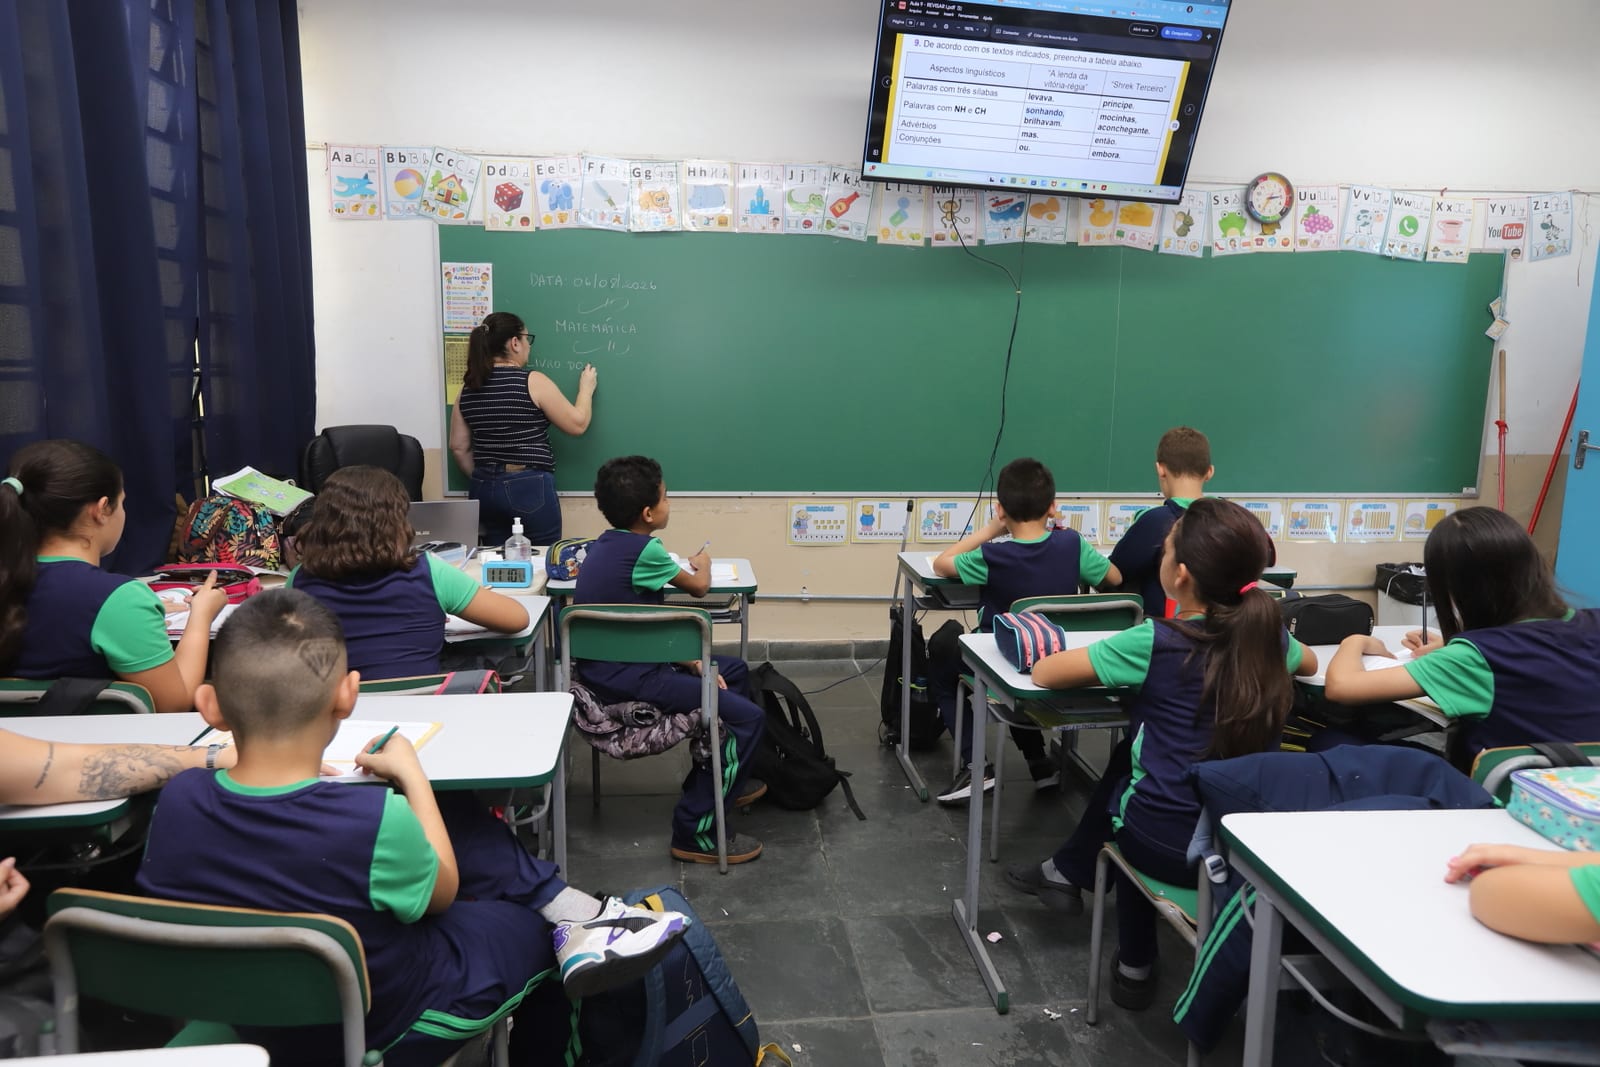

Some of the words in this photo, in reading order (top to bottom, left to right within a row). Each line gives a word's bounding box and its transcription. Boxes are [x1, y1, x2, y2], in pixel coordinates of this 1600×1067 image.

[914, 39, 921, 47] 9.
[936, 41, 962, 51] acordo
[992, 47, 1013, 56] textos
[1053, 53, 1087, 64] preencha
[1095, 56, 1116, 66] tabela
[930, 64, 963, 75] Aspectos
[966, 66, 1006, 78] linguísticos
[1057, 71, 1078, 80] lenda
[906, 81, 938, 92] Palavras
[957, 85, 970, 95] três
[1028, 93, 1054, 102] levava.
[903, 100, 935, 110] Palavras
[1026, 107, 1064, 117] sonhando,
[1024, 118, 1062, 127] brilhavam.
[1100, 114, 1137, 124] mocinhas,
[901, 120, 936, 130] Advérbios
[1098, 125, 1150, 135] aconchegante.
[900, 132, 941, 144] Conjunções
[332, 152, 341, 161] A
[345, 154, 352, 162] a
[386, 153, 394, 163] B
[398, 152, 406, 163] b
[1092, 150, 1120, 159] embora.
[435, 153, 444, 163] C
[447, 158, 454, 167] c
[487, 166, 495, 176] D
[499, 165, 506, 176] d
[537, 165, 543, 175] E
[548, 166, 555, 174] e
[588, 162, 594, 172] F
[600, 164, 605, 174] f
[688, 167, 696, 176] H
[700, 166, 706, 176] h
[632, 167, 641, 178] G
[645, 170, 652, 180] g
[789, 170, 793, 180] J
[833, 172, 840, 182] K
[844, 173, 850, 184] k
[1299, 192, 1306, 200] U
[1354, 190, 1361, 199] V
[1213, 195, 1219, 205] S
[1224, 196, 1229, 204] s
[1394, 197, 1403, 205] W
[1436, 202, 1443, 211] X
[1490, 204, 1496, 213] Y
[1500, 206, 1506, 215] y
[1533, 201, 1540, 210] Z
